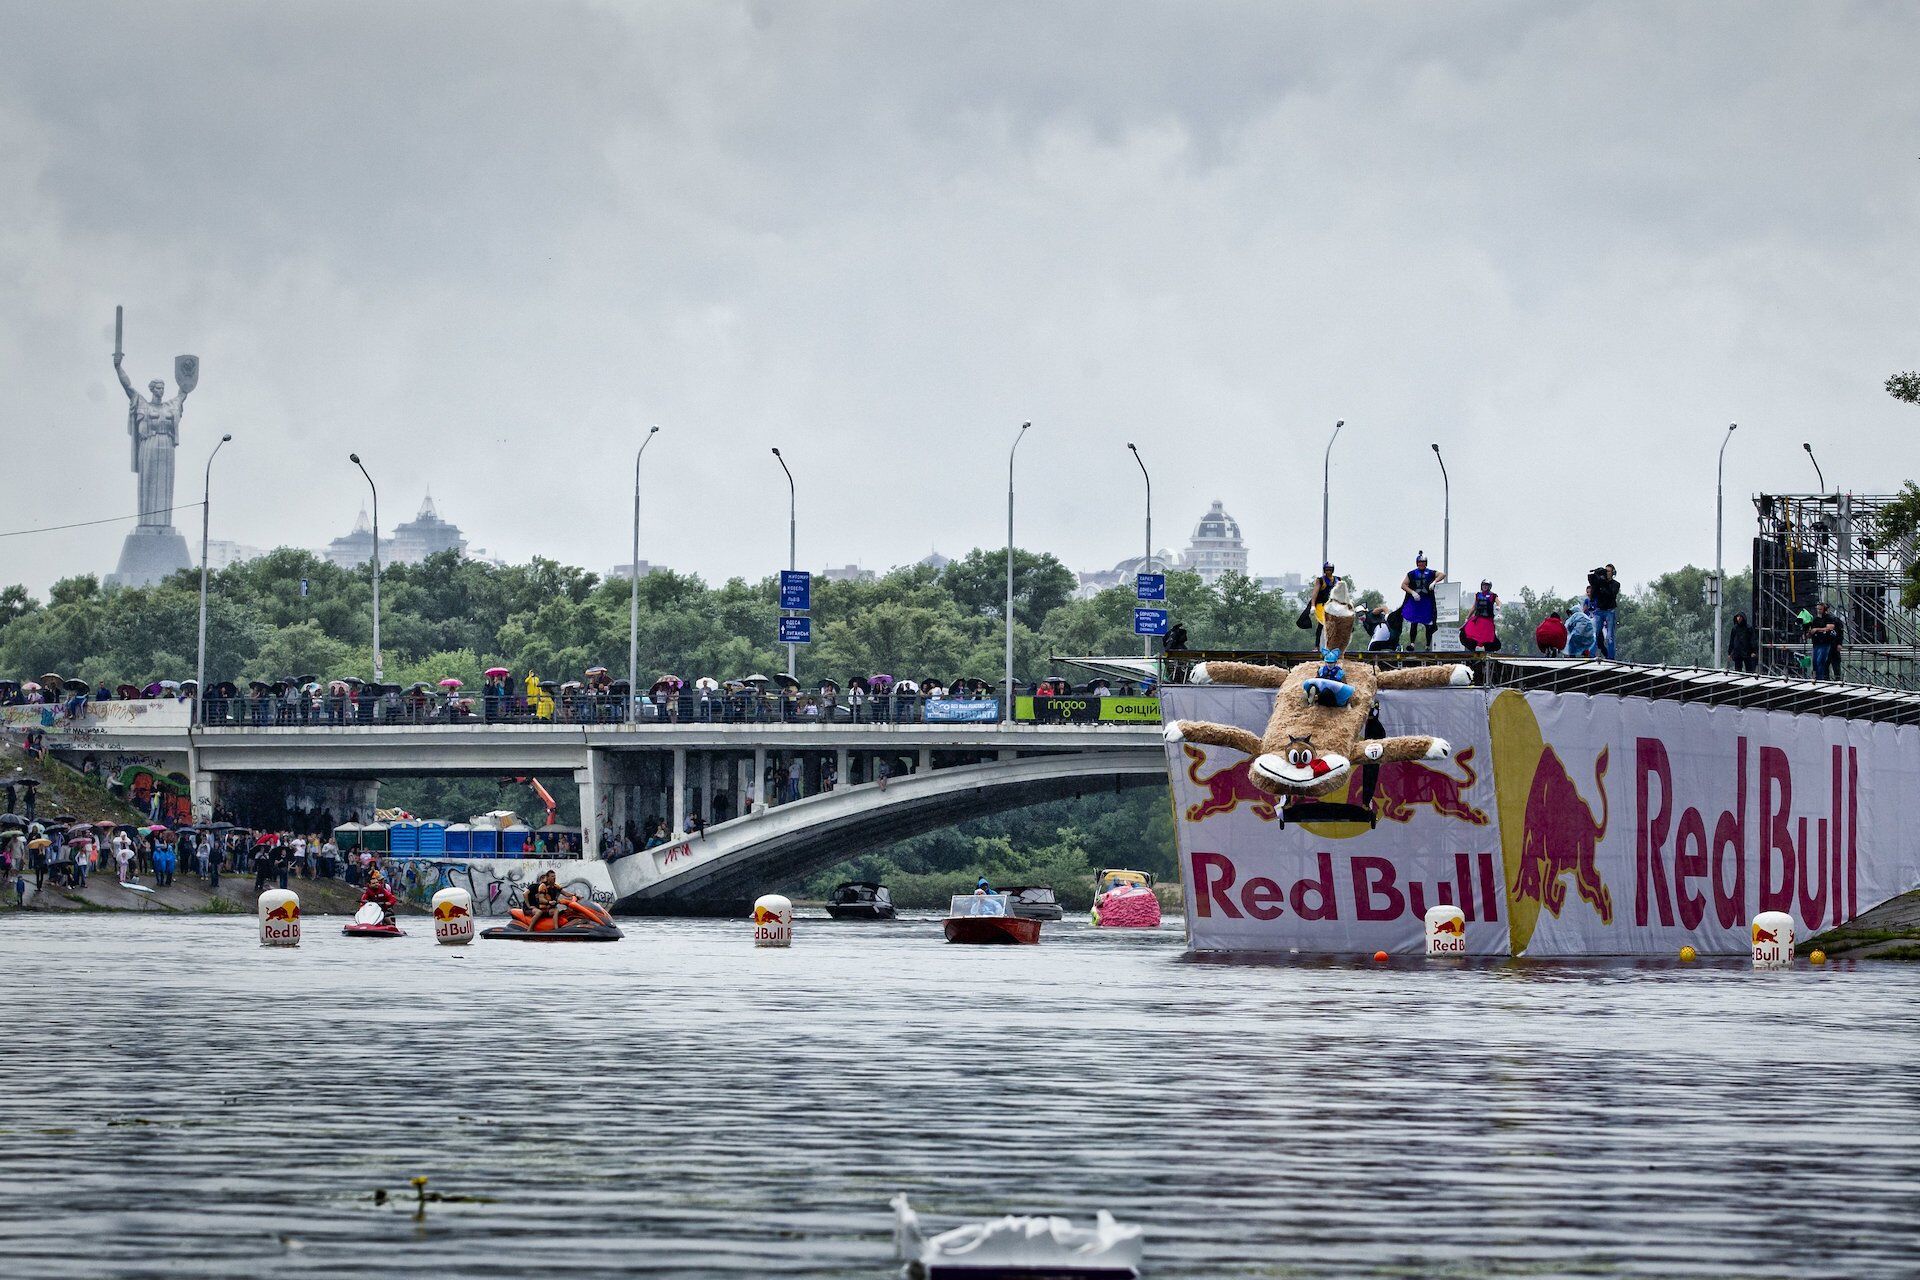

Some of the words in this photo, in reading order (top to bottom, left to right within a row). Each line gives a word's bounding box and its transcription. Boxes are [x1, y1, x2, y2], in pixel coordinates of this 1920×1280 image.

[1048, 699, 1087, 718] ringoo
[1636, 736, 1748, 931] Red
[1759, 744, 1858, 931] Bull
[1190, 852, 1339, 921] Red
[1350, 853, 1498, 922] Bull
[265, 924, 290, 939] Red
[292, 924, 300, 938] B
[436, 923, 448, 937] ed
[450, 920, 472, 936] Bull
[761, 926, 783, 940] Bull
[1433, 938, 1458, 951] Red
[1755, 946, 1779, 961] Bull
